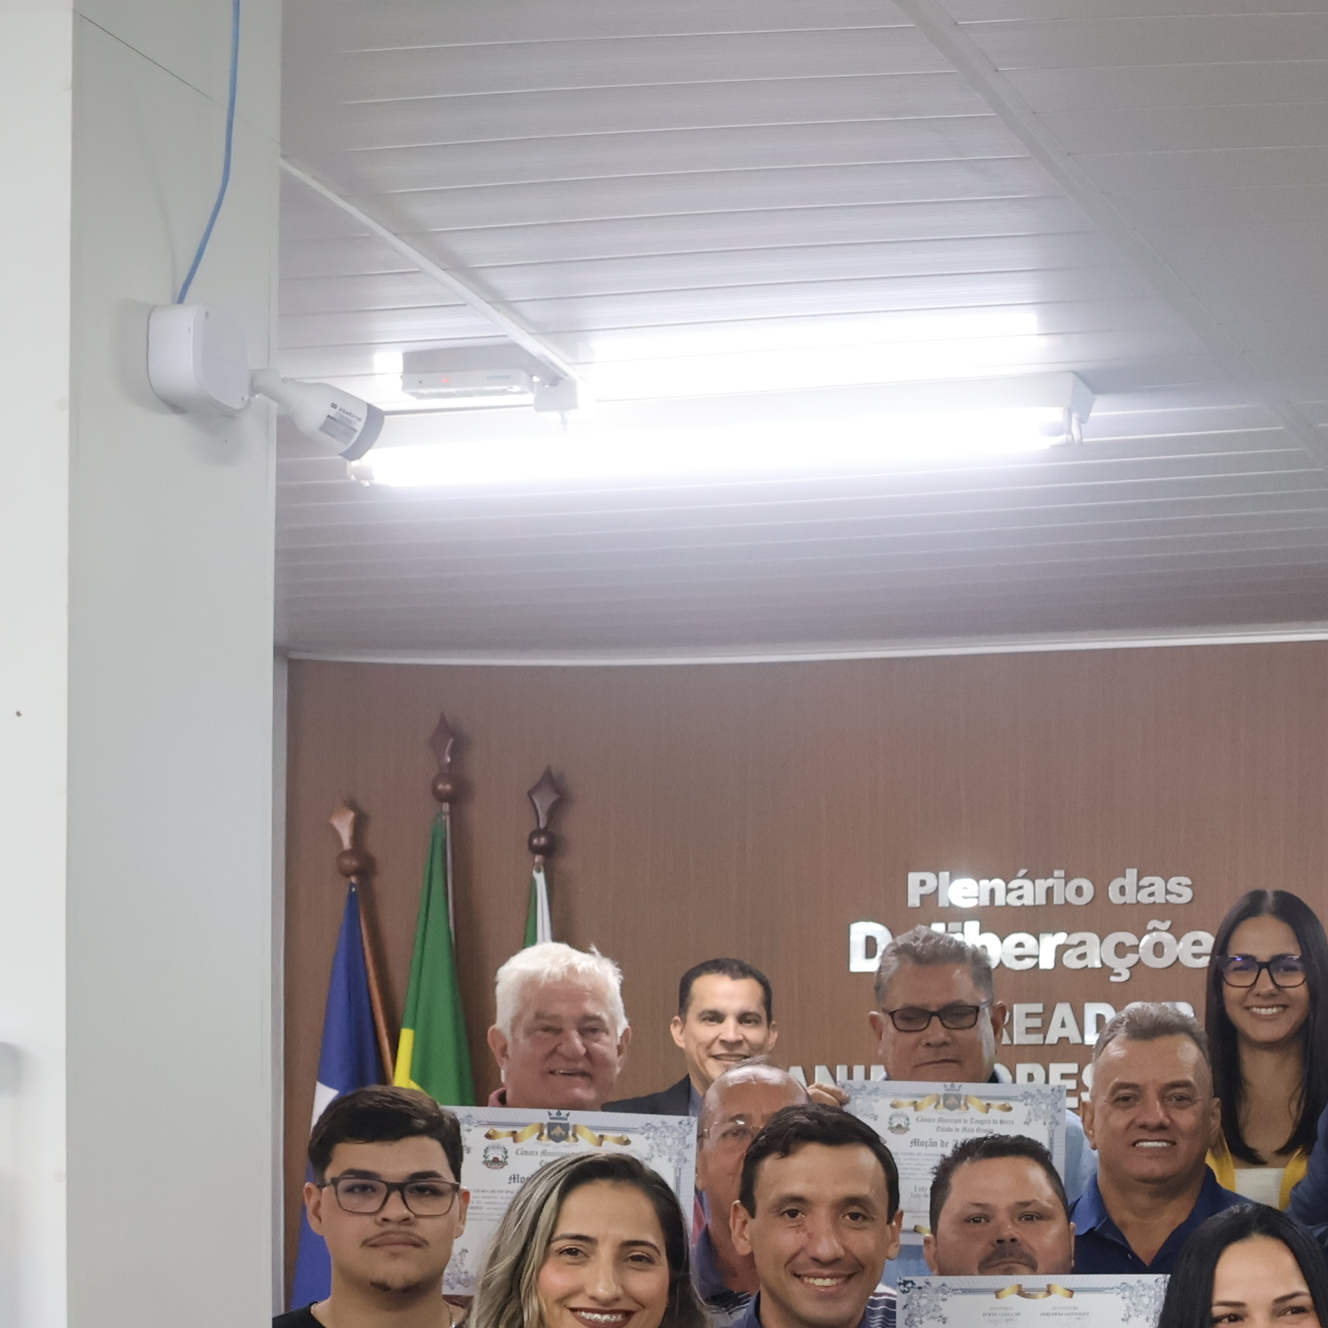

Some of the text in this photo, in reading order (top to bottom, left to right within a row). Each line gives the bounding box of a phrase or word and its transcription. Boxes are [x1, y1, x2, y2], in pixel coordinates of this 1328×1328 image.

[907, 868, 1193, 908] Plenário das
[849, 919, 1215, 983] Dberaçõe
